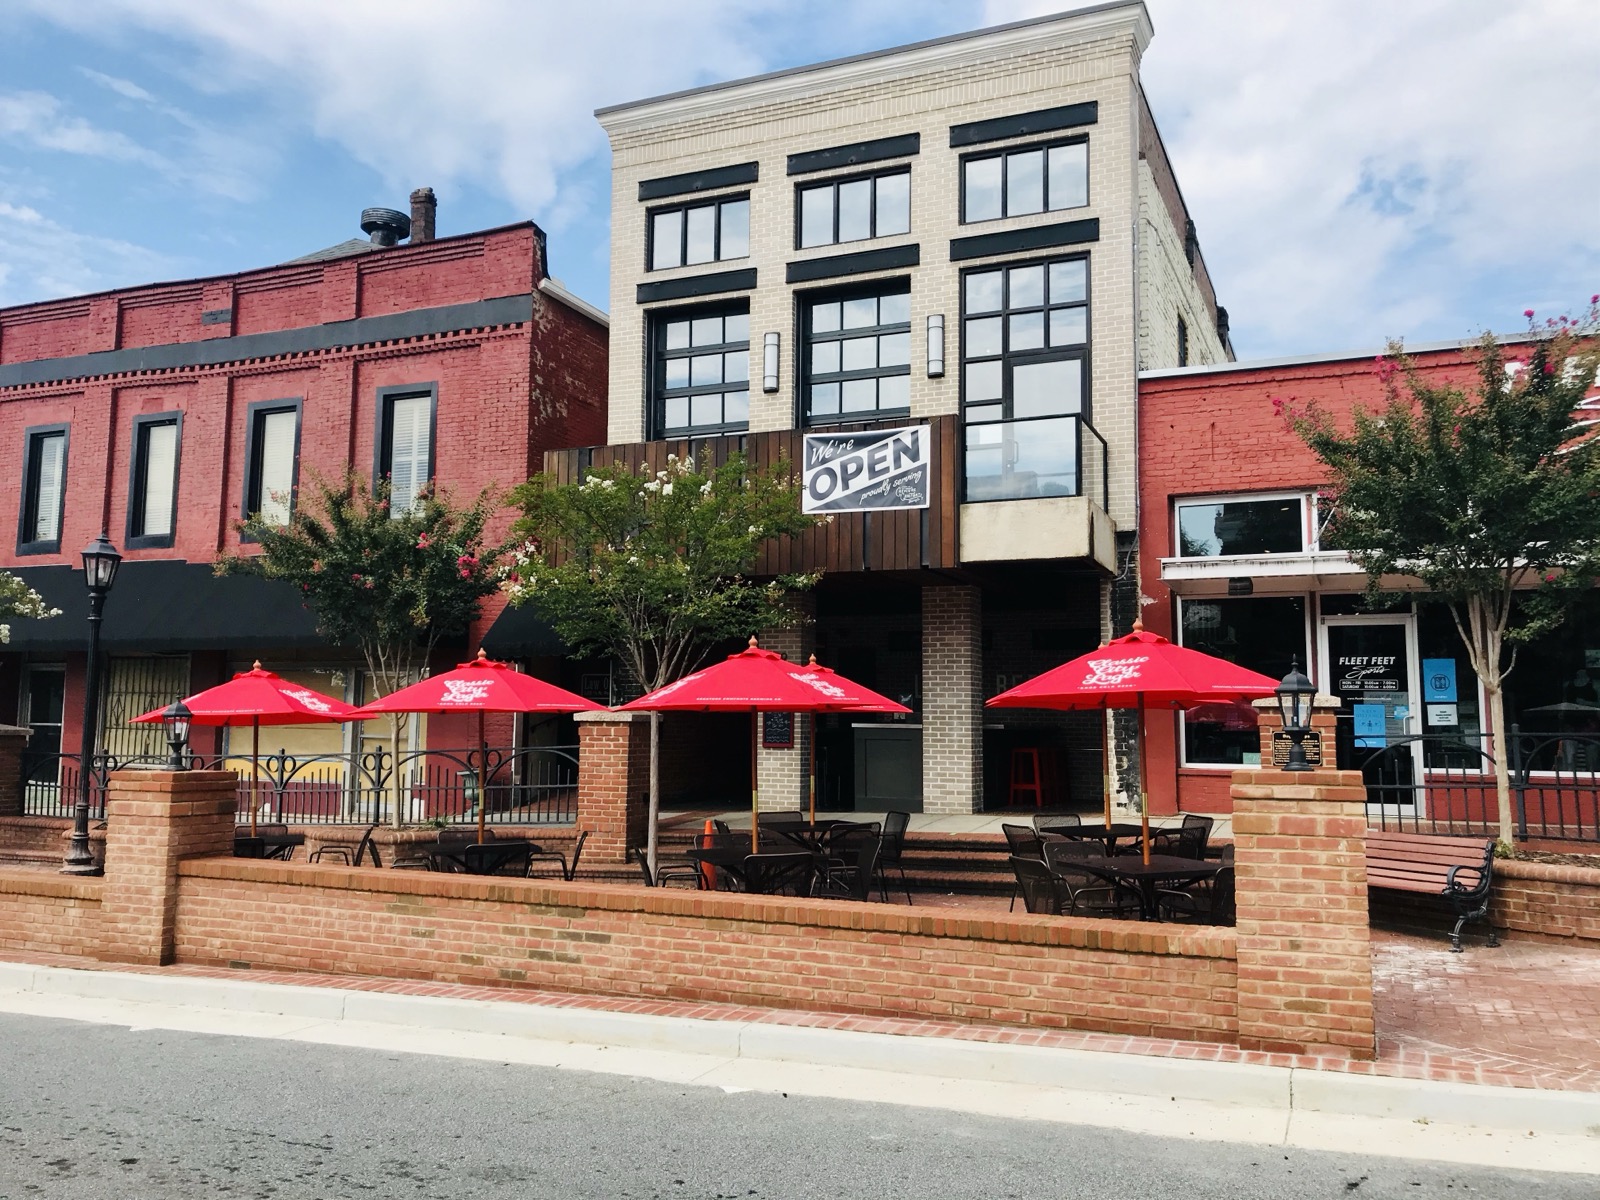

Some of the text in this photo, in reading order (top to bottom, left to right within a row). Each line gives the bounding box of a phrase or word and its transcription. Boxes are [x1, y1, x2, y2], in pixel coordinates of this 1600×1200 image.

[811, 438, 855, 465] We're
[809, 429, 921, 501] OPEN
[859, 478, 892, 505] proudly
[893, 470, 922, 488] serving
[1087, 656, 1149, 667] Classic
[1339, 656, 1396, 665] FLEET FEET
[1093, 665, 1141, 676] City
[1345, 665, 1391, 680] Sports
[443, 680, 494, 688] Classic
[1082, 672, 1142, 685] Lager
